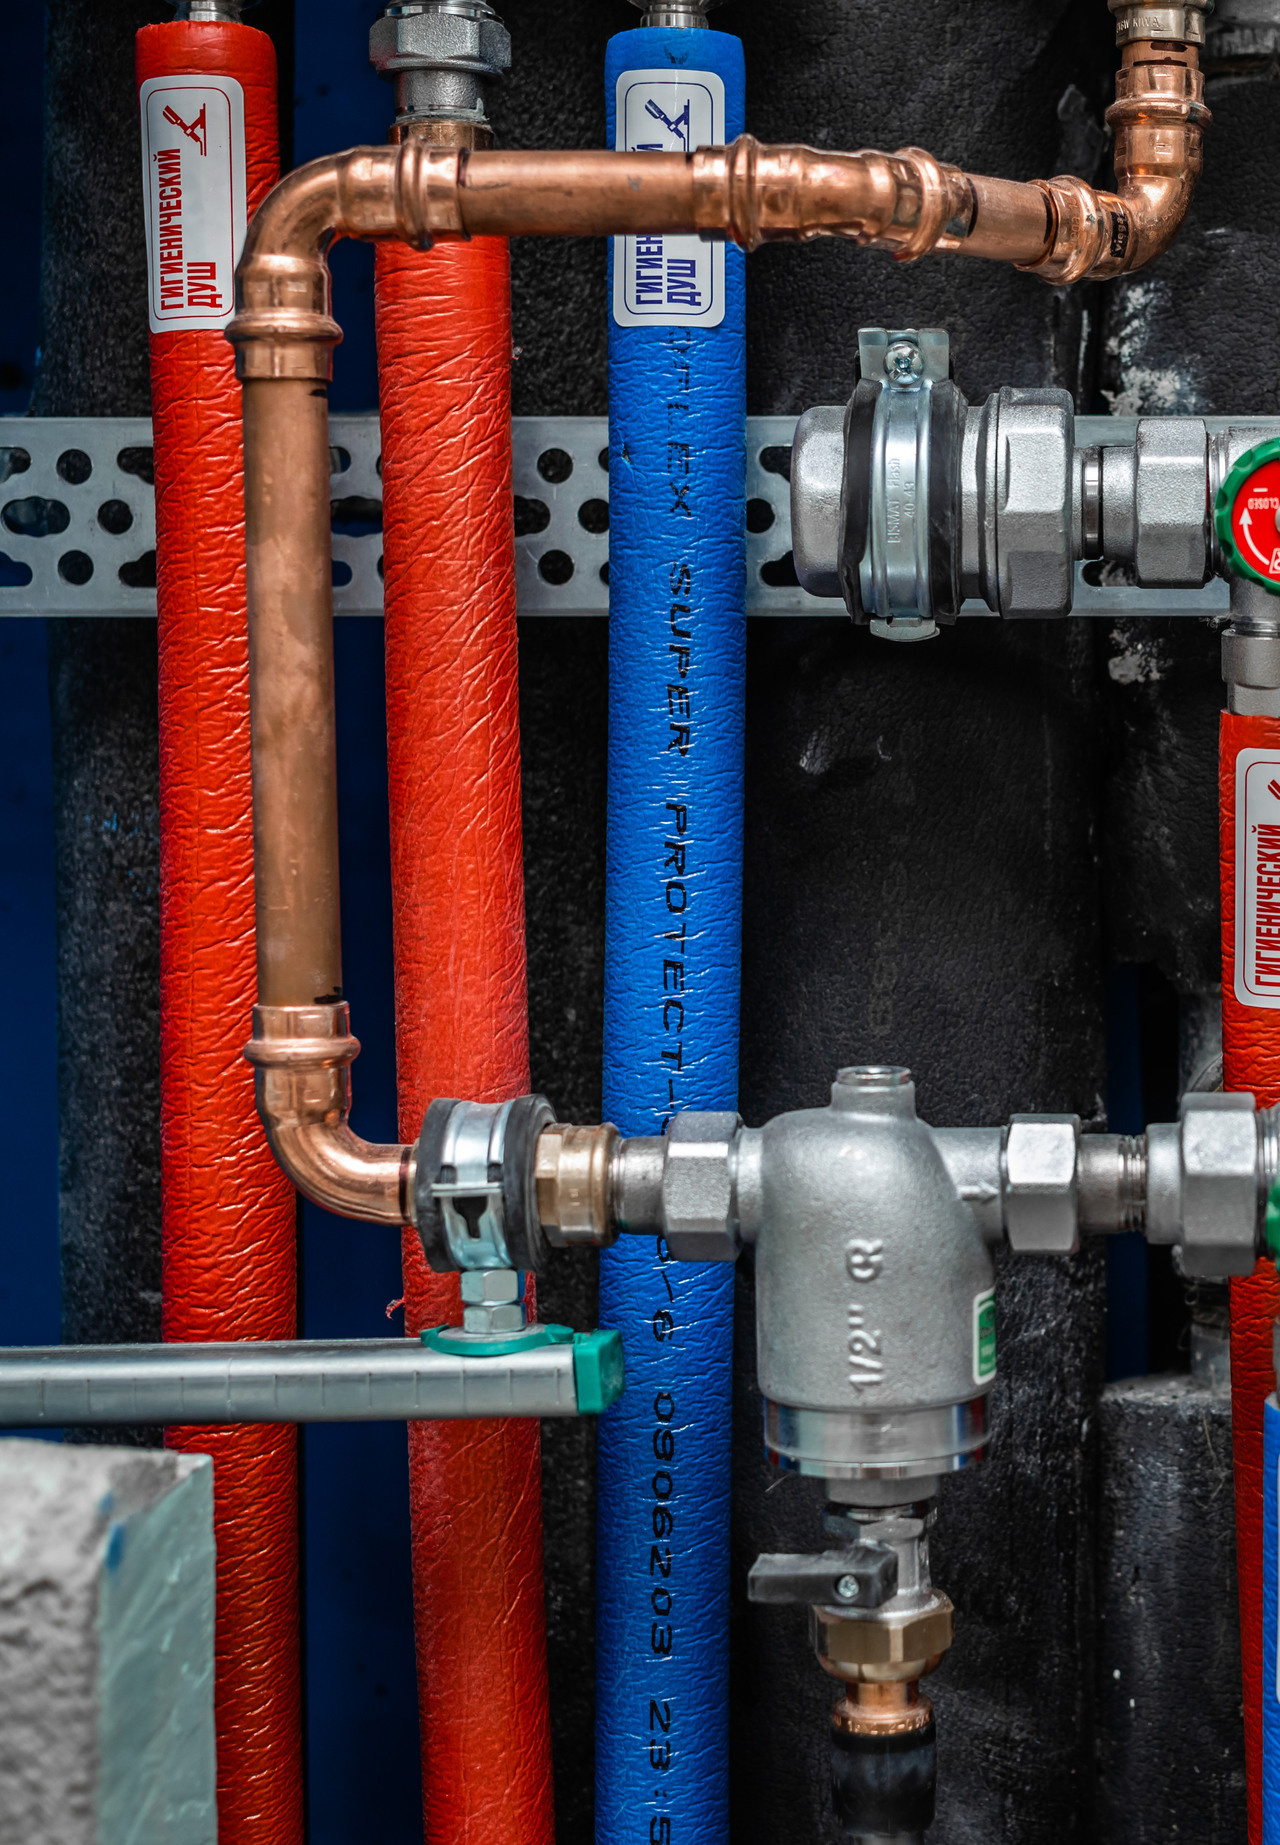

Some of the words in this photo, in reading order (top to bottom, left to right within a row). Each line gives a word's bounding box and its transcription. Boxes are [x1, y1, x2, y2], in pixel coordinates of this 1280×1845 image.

[152, 147, 183, 311] ГИГИЕНИЧЕСКИЙ
[187, 261, 223, 309] ДУШ
[667, 258, 702, 308] ДУШ
[1247, 496, 1280, 510] CLOSED
[664, 561, 694, 760] SUPER
[847, 1303, 885, 1392] 1/2"
[648, 1390, 678, 1657] 0906203
